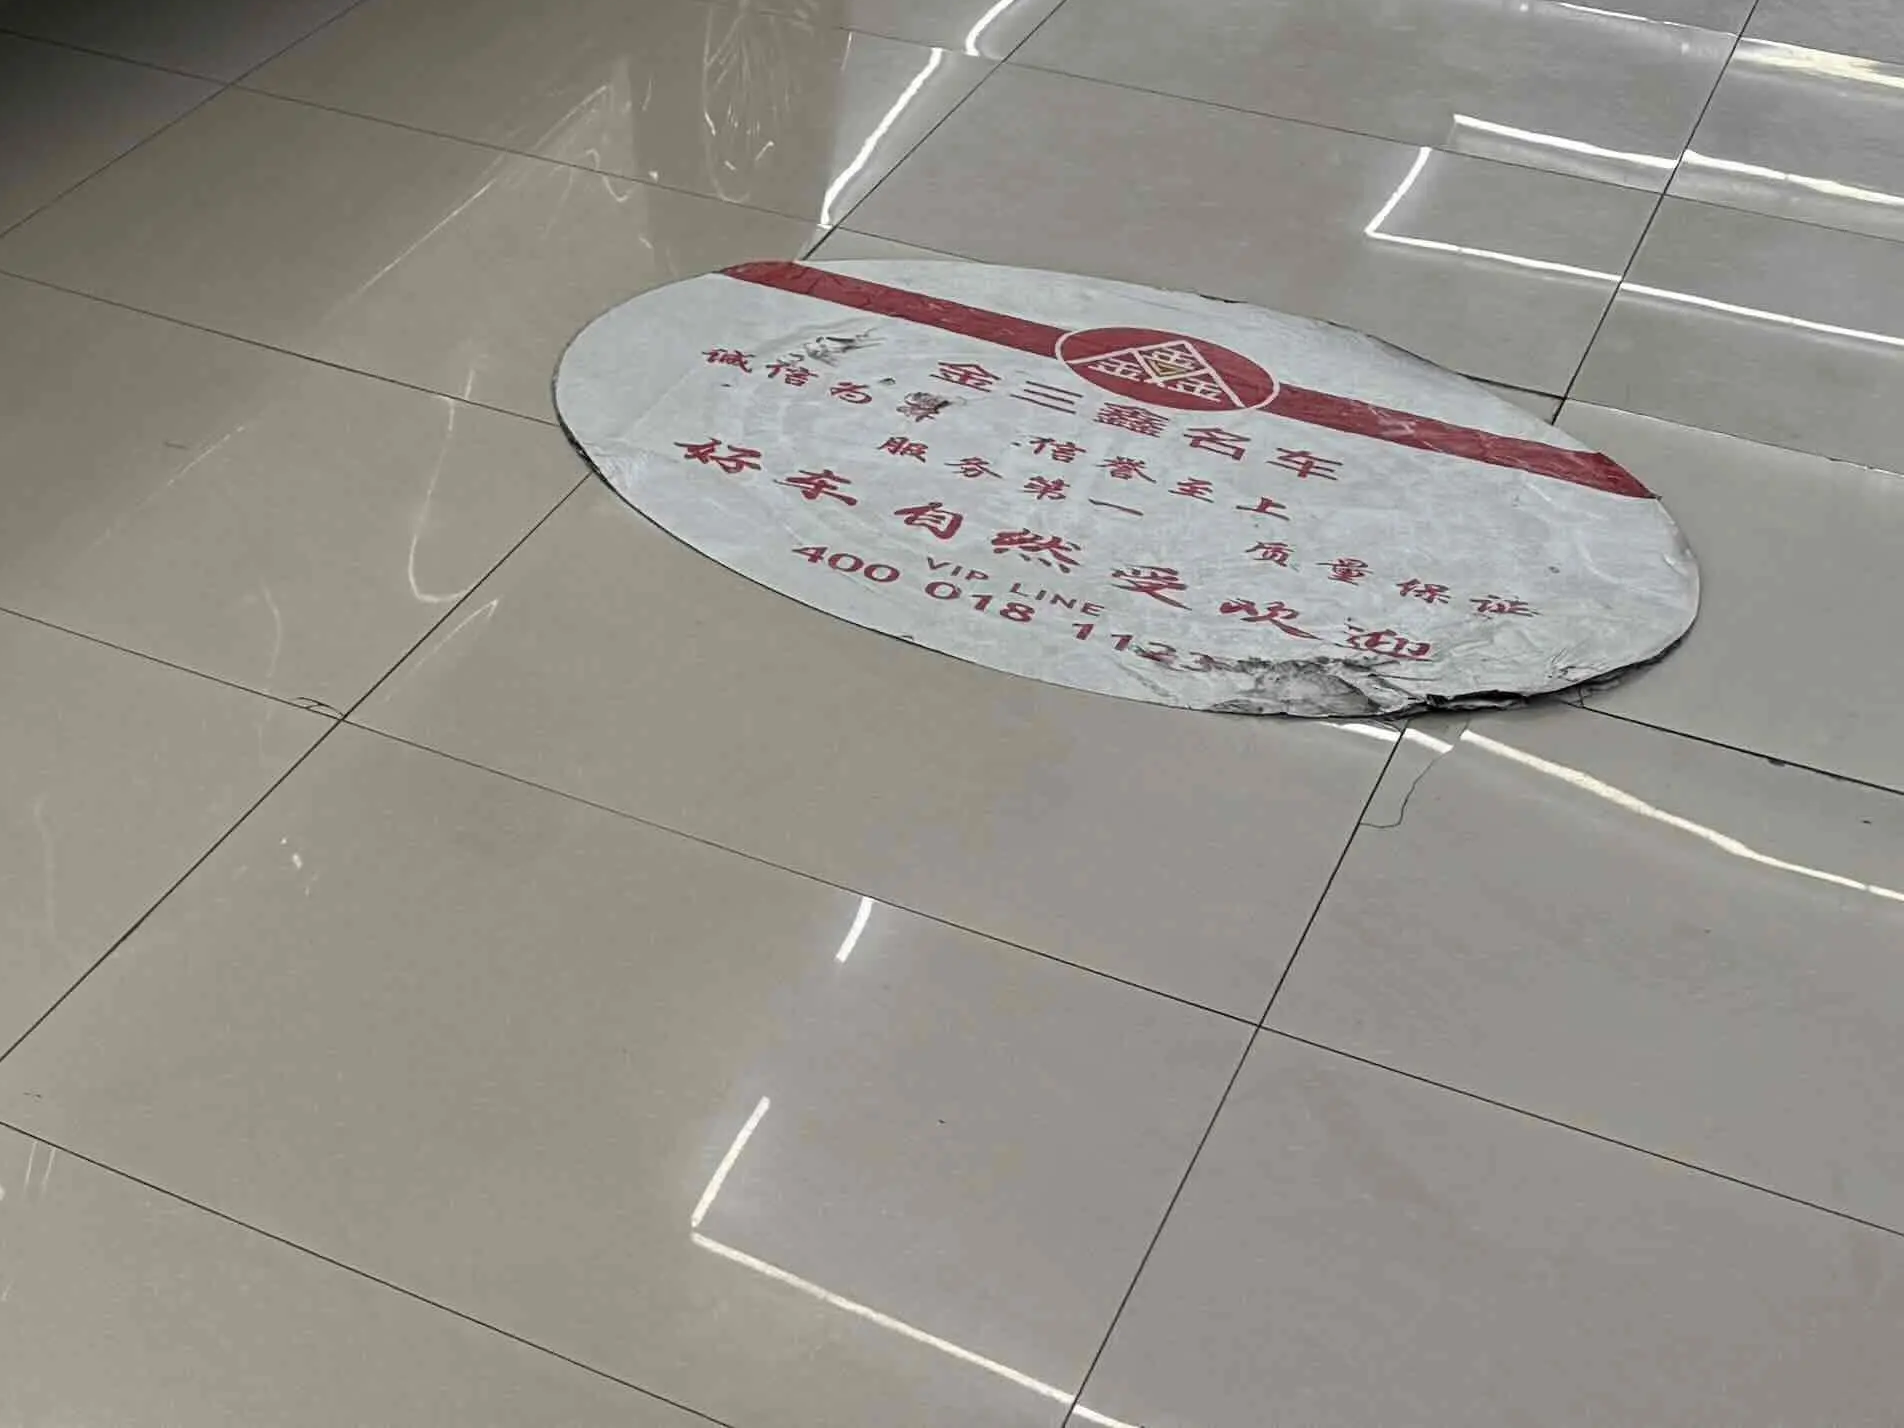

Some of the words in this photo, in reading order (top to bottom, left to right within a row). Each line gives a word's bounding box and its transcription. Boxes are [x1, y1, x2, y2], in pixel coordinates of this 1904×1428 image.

[929, 359, 1343, 482] 金三鑫名车
[876, 436, 1145, 517] 服务第一
[1244, 540, 1545, 619] 质量保证
[1029, 435, 1291, 521] 信誉至上
[672, 437, 1435, 663] 好车自然受欢迎
[790, 545, 901, 584] 400
[923, 580, 1037, 624] 018
[926, 556, 990, 582] VIP
[1009, 581, 1106, 618] LINE
